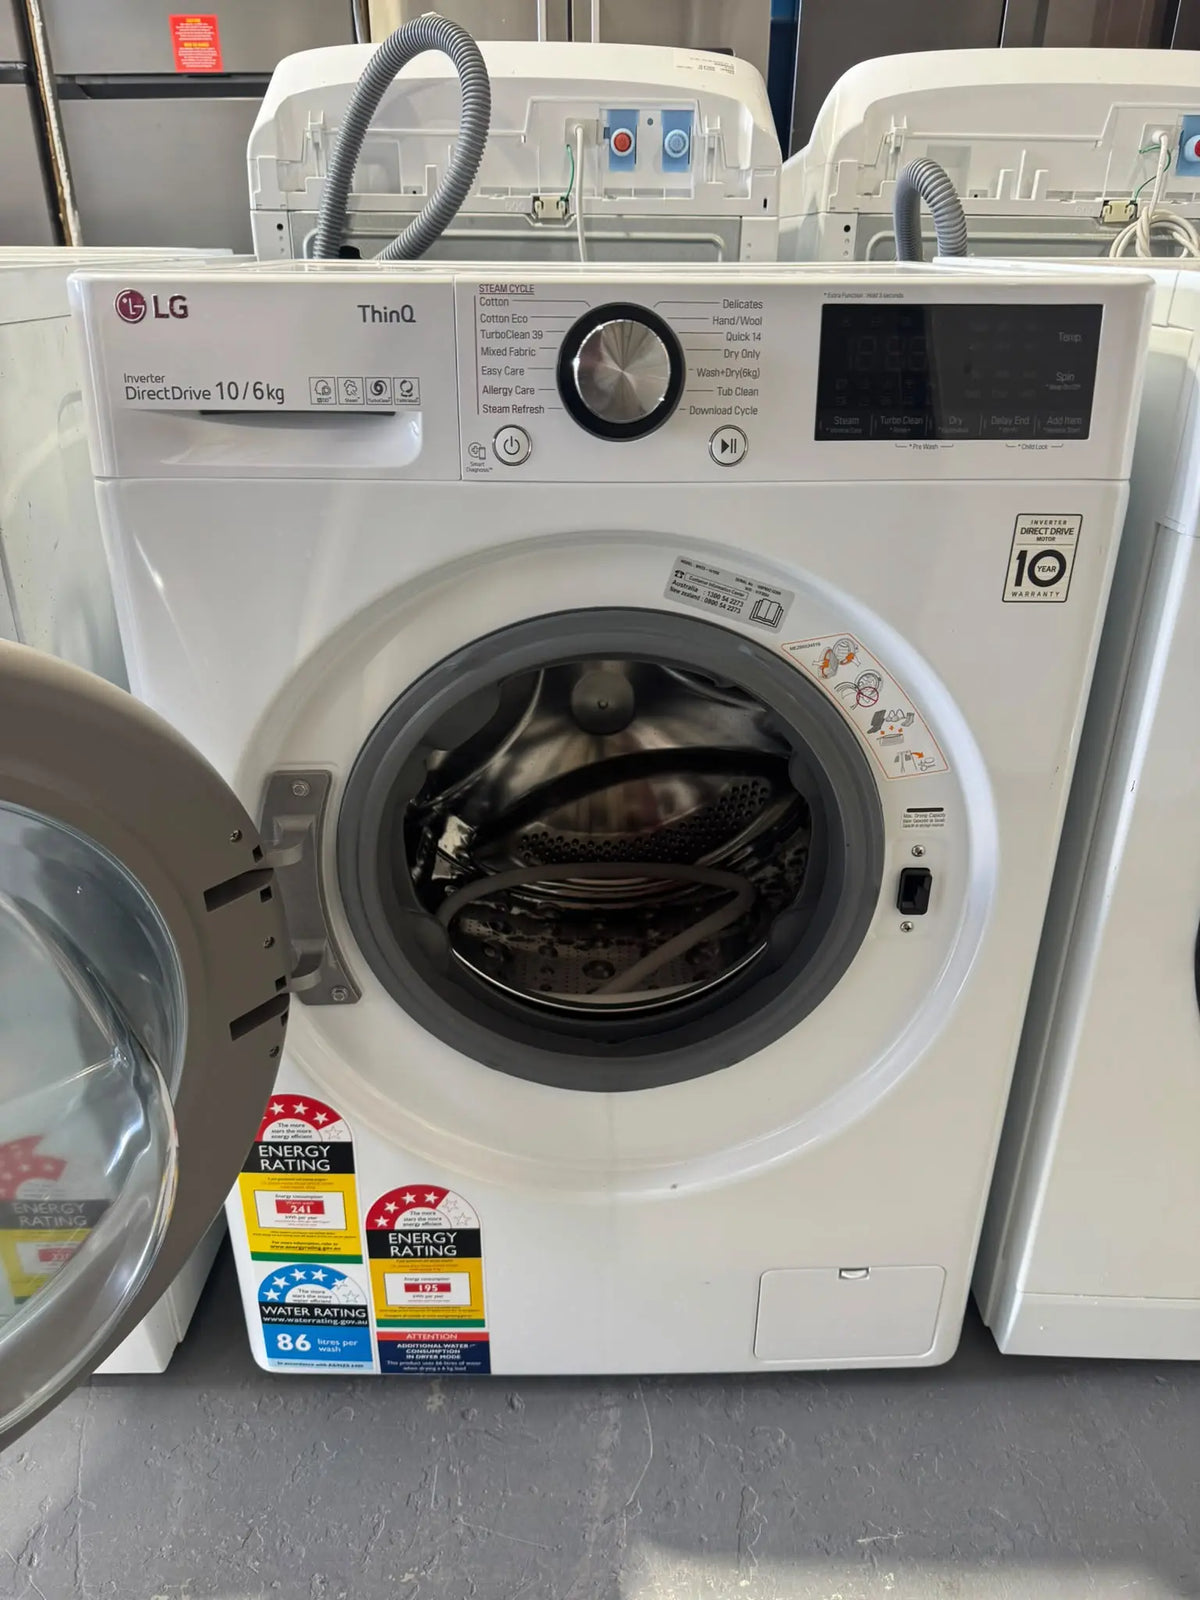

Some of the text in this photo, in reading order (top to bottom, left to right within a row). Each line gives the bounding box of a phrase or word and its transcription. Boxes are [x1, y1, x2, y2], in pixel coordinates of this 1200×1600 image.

[479, 284, 535, 294] STEAM CYCLE
[152, 294, 189, 319] LG
[480, 297, 509, 307] Cotton
[723, 299, 763, 309] Delicates
[357, 304, 416, 323] ThinQ
[480, 314, 528, 324] Cotton Eco
[712, 316, 762, 326] Hand/Wool
[480, 329, 543, 340] TurboClean 39
[726, 332, 761, 342] Quick 14
[481, 347, 536, 357] Mixed Fabric
[724, 348, 761, 360] Dry Only
[481, 366, 525, 378] Easy Care
[697, 367, 760, 380] Wash+Dry(6kg)
[1056, 371, 1075, 384] Spin
[124, 373, 165, 384] Inverter
[482, 385, 535, 397] Allergy Care
[717, 386, 759, 396] Tub Clean
[482, 404, 544, 414] Steam Refresh
[689, 405, 758, 416] Download Cycle
[833, 416, 860, 425] Steam
[880, 416, 923, 425] Turbo Clean
[949, 416, 963, 426] Dry
[991, 416, 1030, 426] Delay End
[1047, 416, 1082, 425] Add Item
[1020, 527, 1075, 535] DIRECT DRIVE
[1014, 549, 1067, 588] 10
[672, 580, 699, 593] Australia
[729, 597, 744, 608] 2273
[670, 586, 681, 595] New
[726, 604, 741, 614] 2273
[258, 1145, 330, 1158] ENERGY
[260, 1160, 330, 1171] RATING
[14, 1203, 85, 1214] ENERGY
[290, 1205, 311, 1213] 241
[19, 1215, 88, 1226] RATING
[388, 1232, 458, 1245] ENERGY
[390, 1245, 457, 1257] RATING
[418, 1284, 438, 1292] 195
[261, 1306, 367, 1318] WATER RATING
[262, 1316, 368, 1326] www.waterrating.gov.au
[277, 1333, 312, 1352] 86
[317, 1337, 340, 1346] litres
